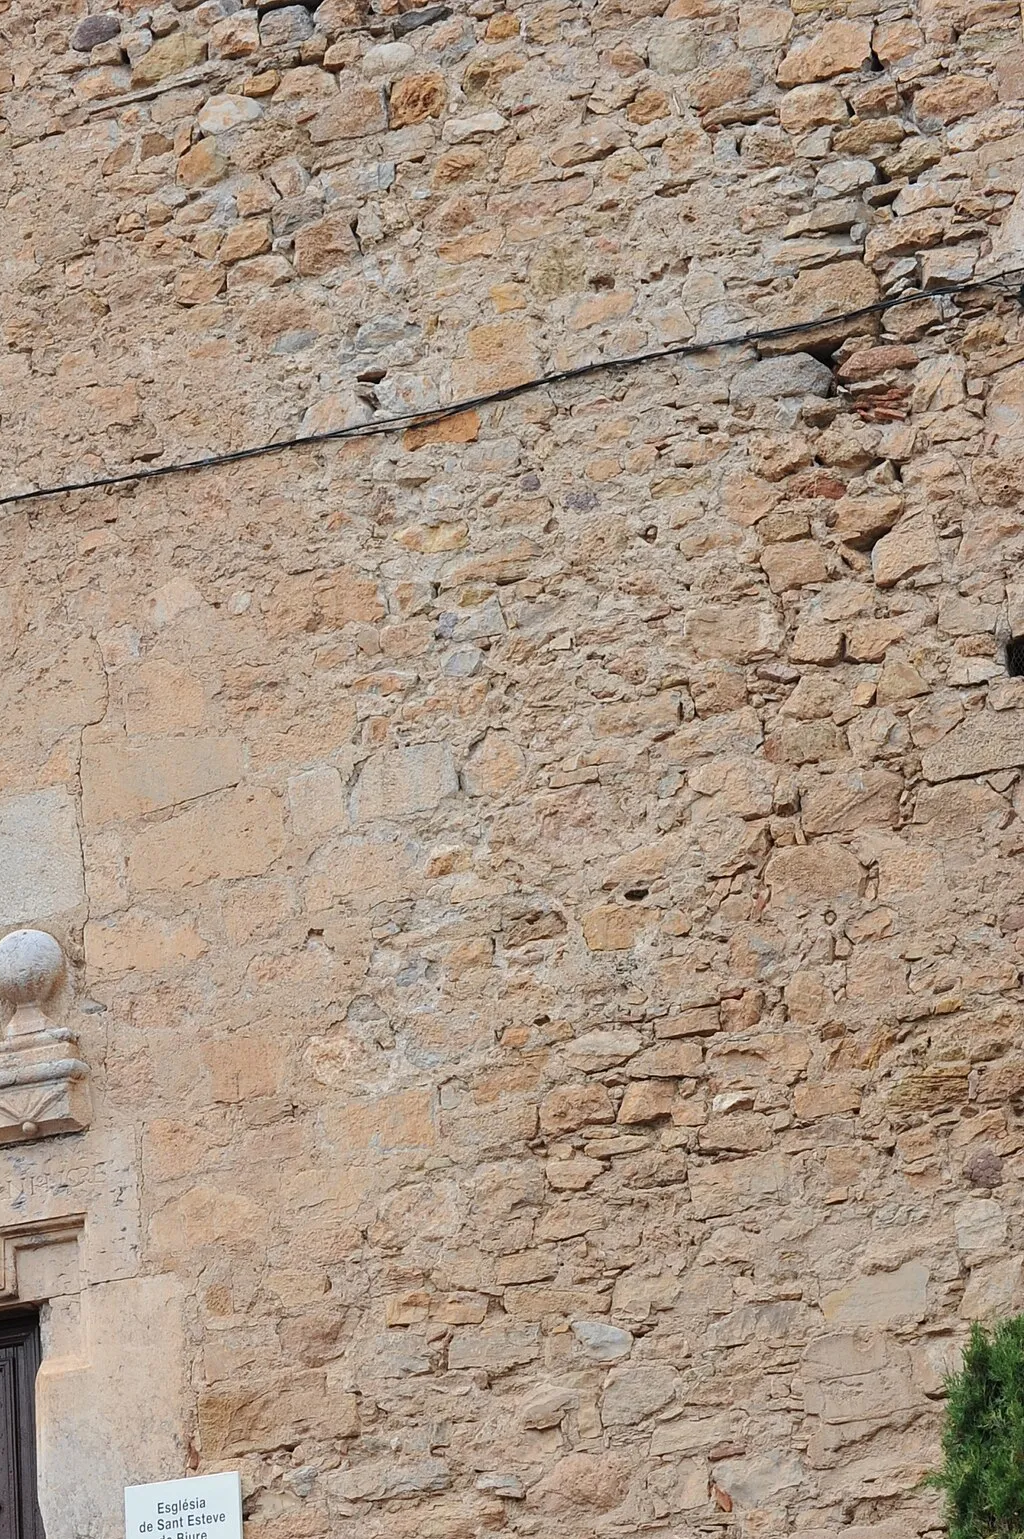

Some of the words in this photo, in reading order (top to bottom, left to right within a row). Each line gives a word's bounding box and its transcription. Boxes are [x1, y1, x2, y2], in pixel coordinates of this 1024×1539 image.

[157, 1497, 206, 1515] Església
[139, 1521, 154, 1533] de
[157, 1516, 184, 1531] Sant
[187, 1512, 226, 1527] Esteve
